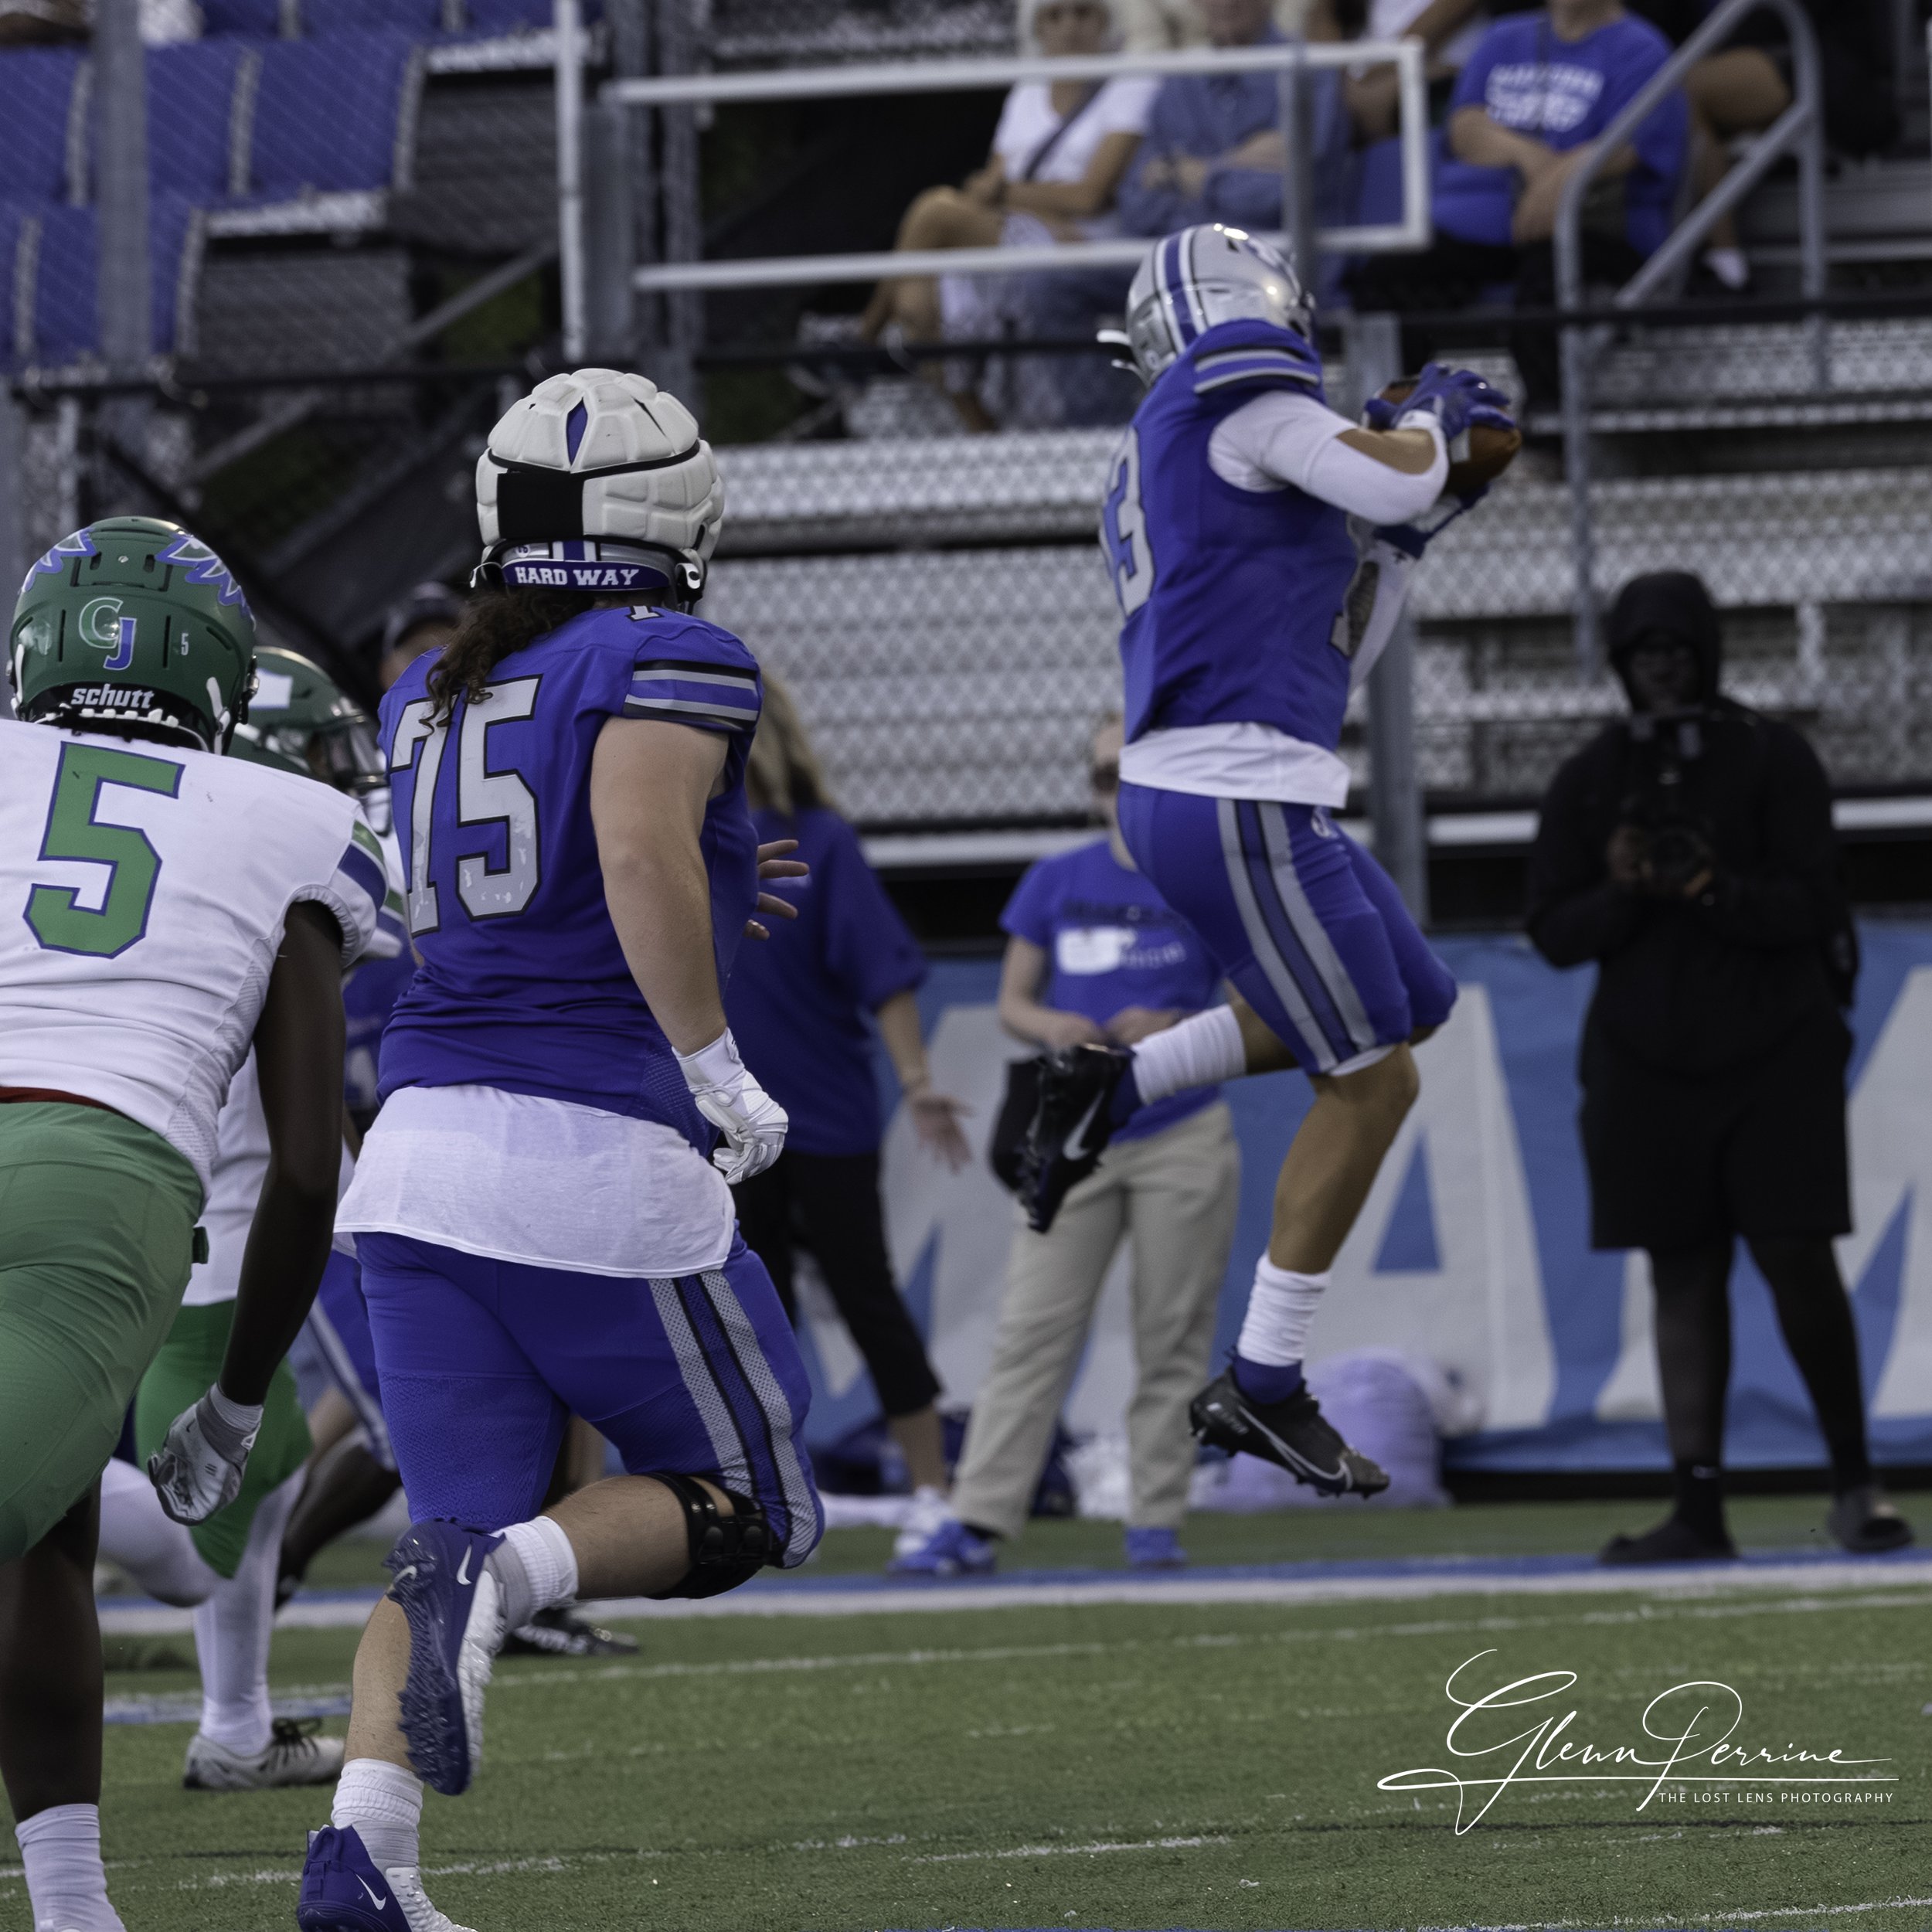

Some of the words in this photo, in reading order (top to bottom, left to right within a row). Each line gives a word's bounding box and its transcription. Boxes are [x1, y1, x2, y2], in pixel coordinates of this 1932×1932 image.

[1100, 426, 1155, 616] 3
[515, 566, 568, 585] HARD
[573, 569, 639, 586] WAY
[70, 683, 155, 709] schutt
[181, 633, 189, 656] 5
[22, 740, 186, 959] 5
[389, 674, 543, 938] 75
